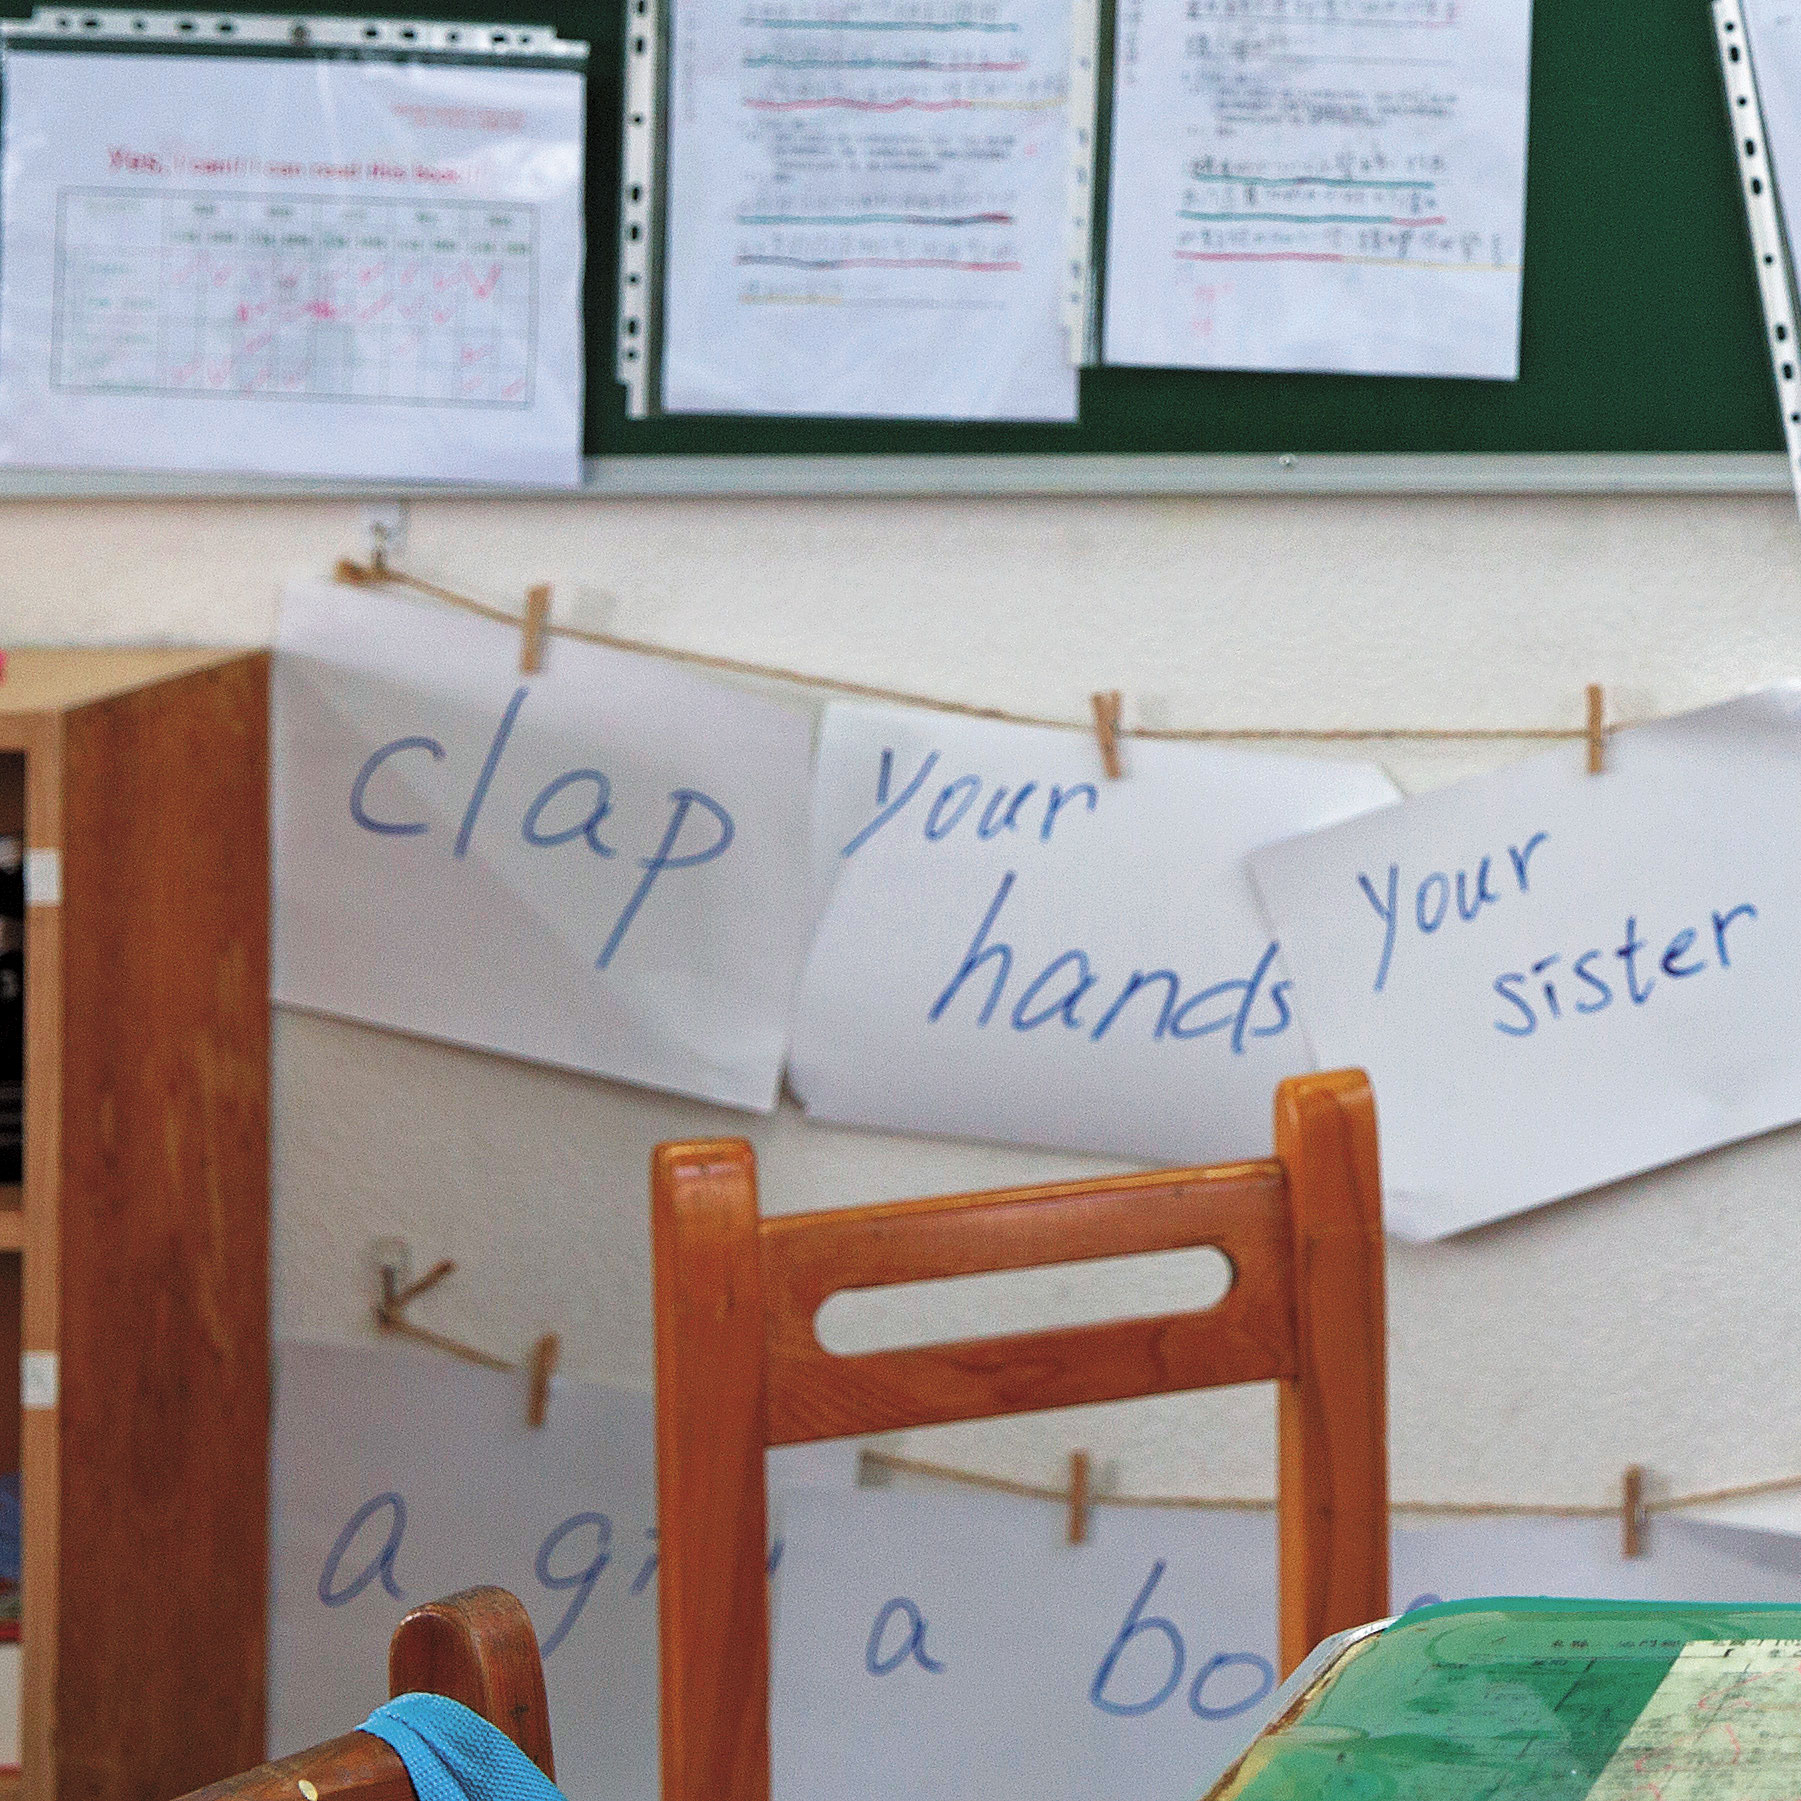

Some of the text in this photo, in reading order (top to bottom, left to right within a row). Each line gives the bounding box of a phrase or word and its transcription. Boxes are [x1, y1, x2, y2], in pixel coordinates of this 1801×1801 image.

[347, 685, 736, 972] clap
[842, 747, 1098, 861] your
[926, 868, 1294, 1054] hands
[1356, 829, 1551, 991] your
[1493, 900, 1762, 1040] sister
[316, 1490, 406, 1610] a
[865, 1557, 1278, 1722] a bo
